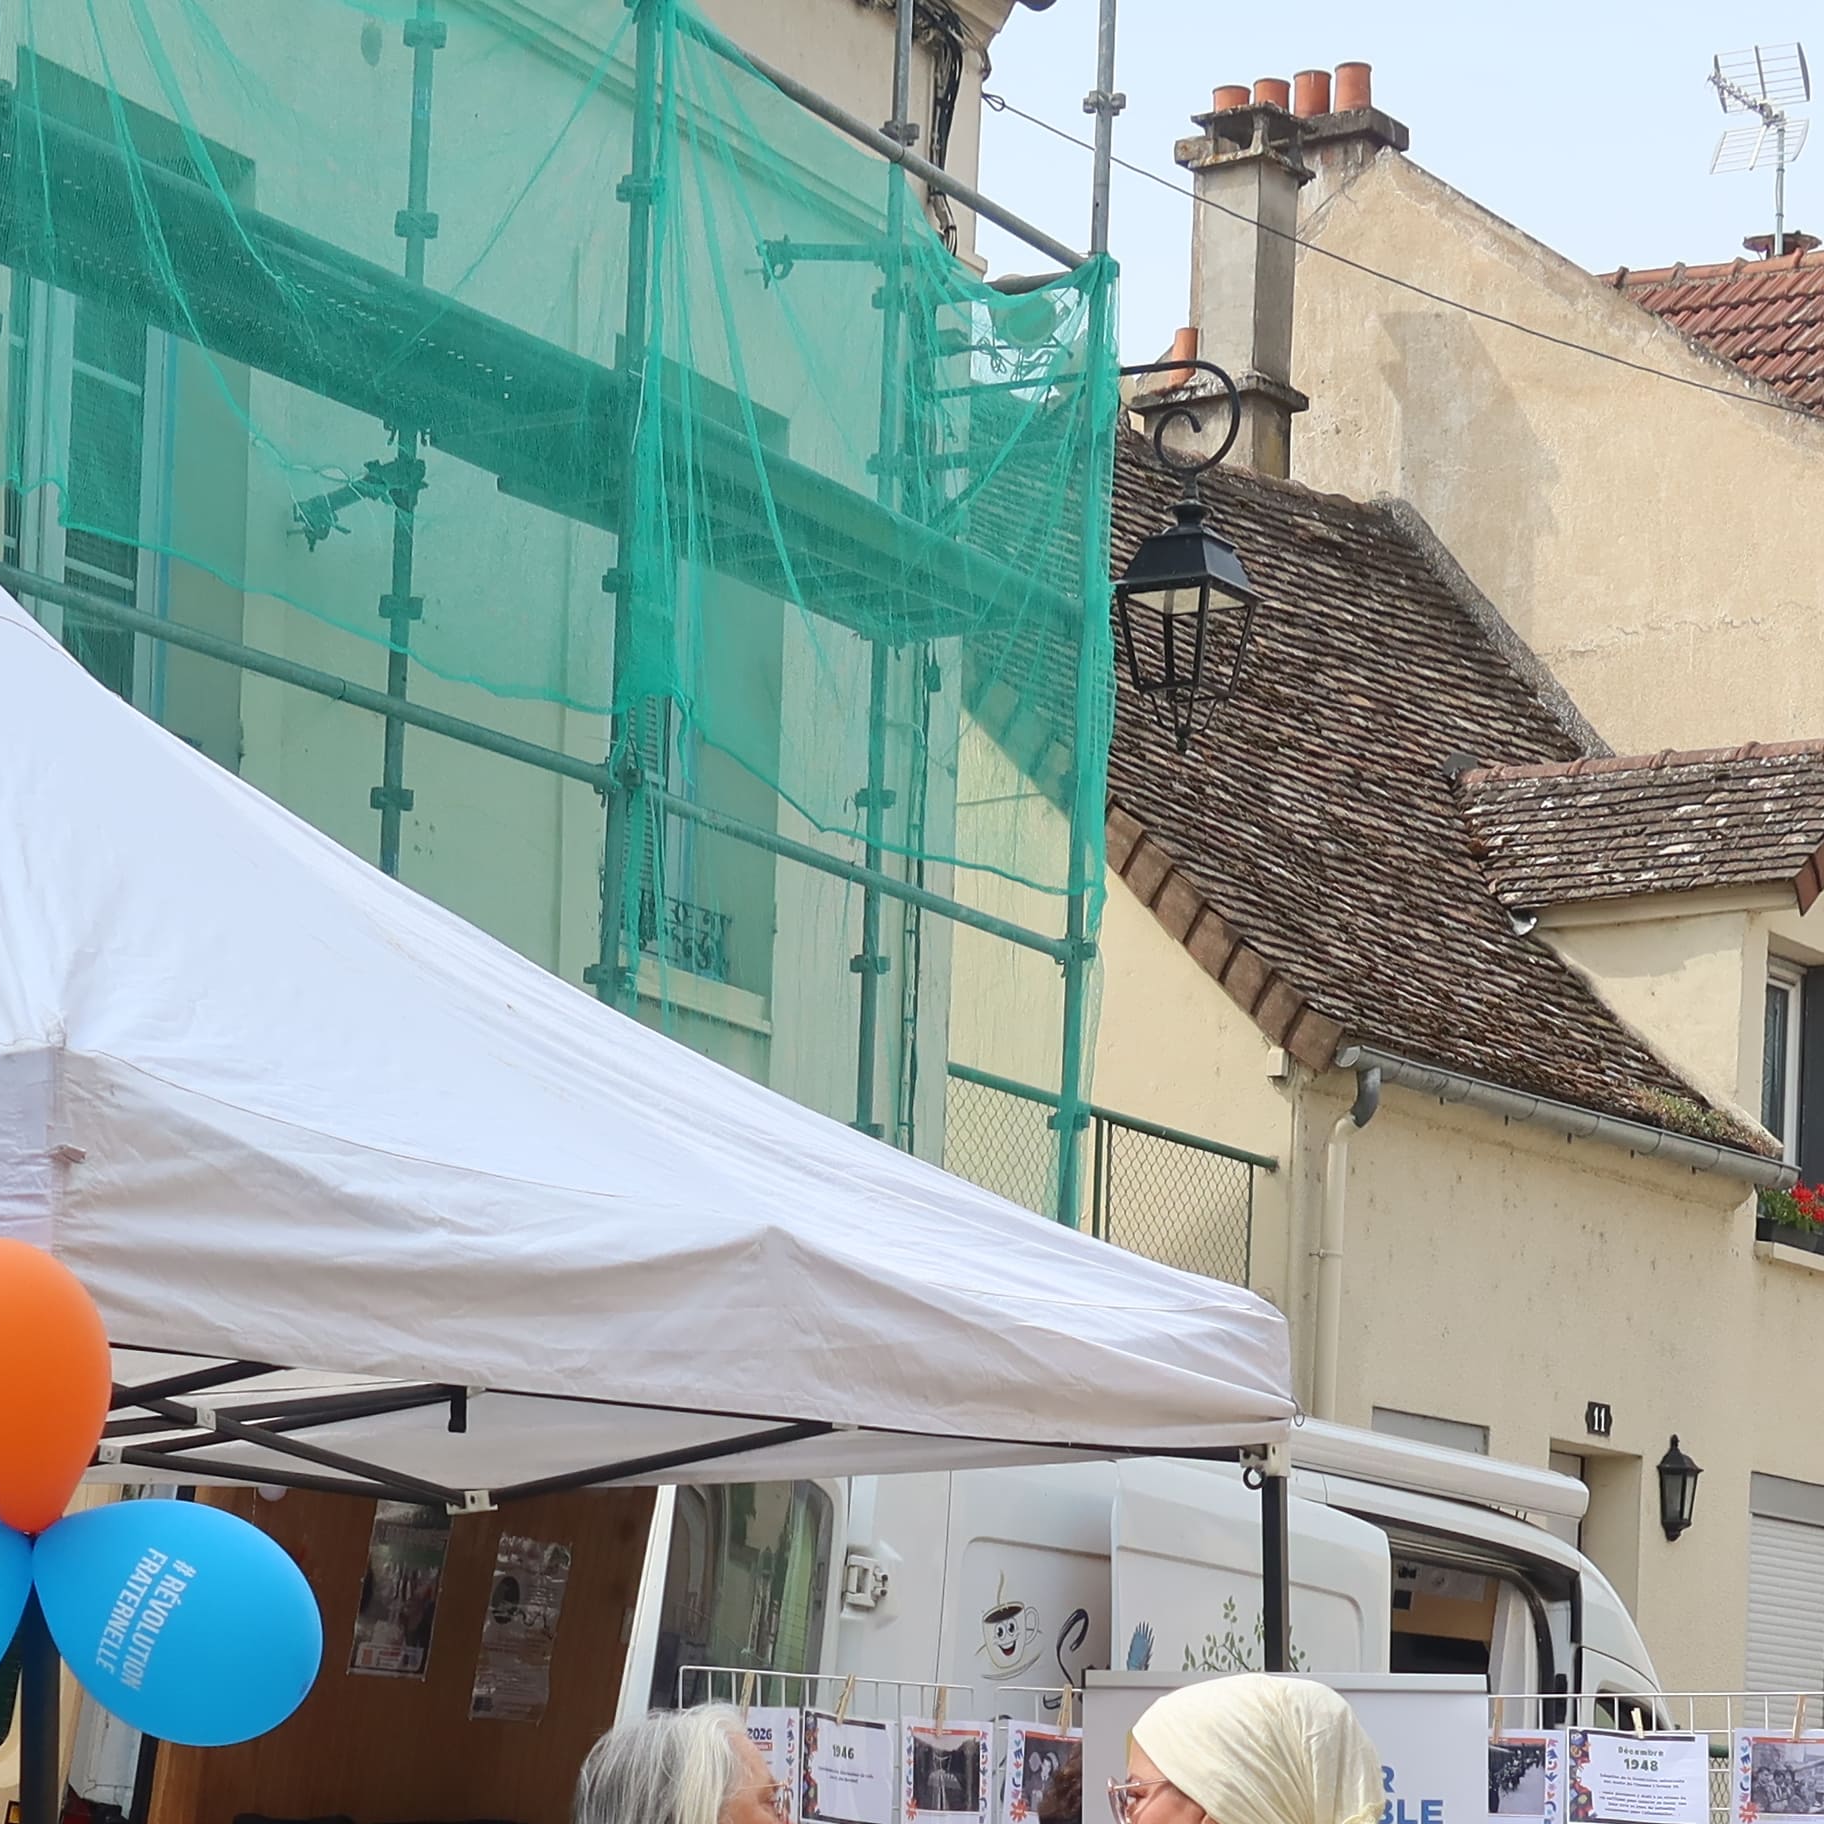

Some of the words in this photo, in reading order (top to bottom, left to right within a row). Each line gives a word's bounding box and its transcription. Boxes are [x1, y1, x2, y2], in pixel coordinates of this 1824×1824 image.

[1594, 1406, 1605, 1432] 11
[96, 1547, 169, 1675] FRATERNELLE
[1624, 1758, 1659, 1772] 1948
